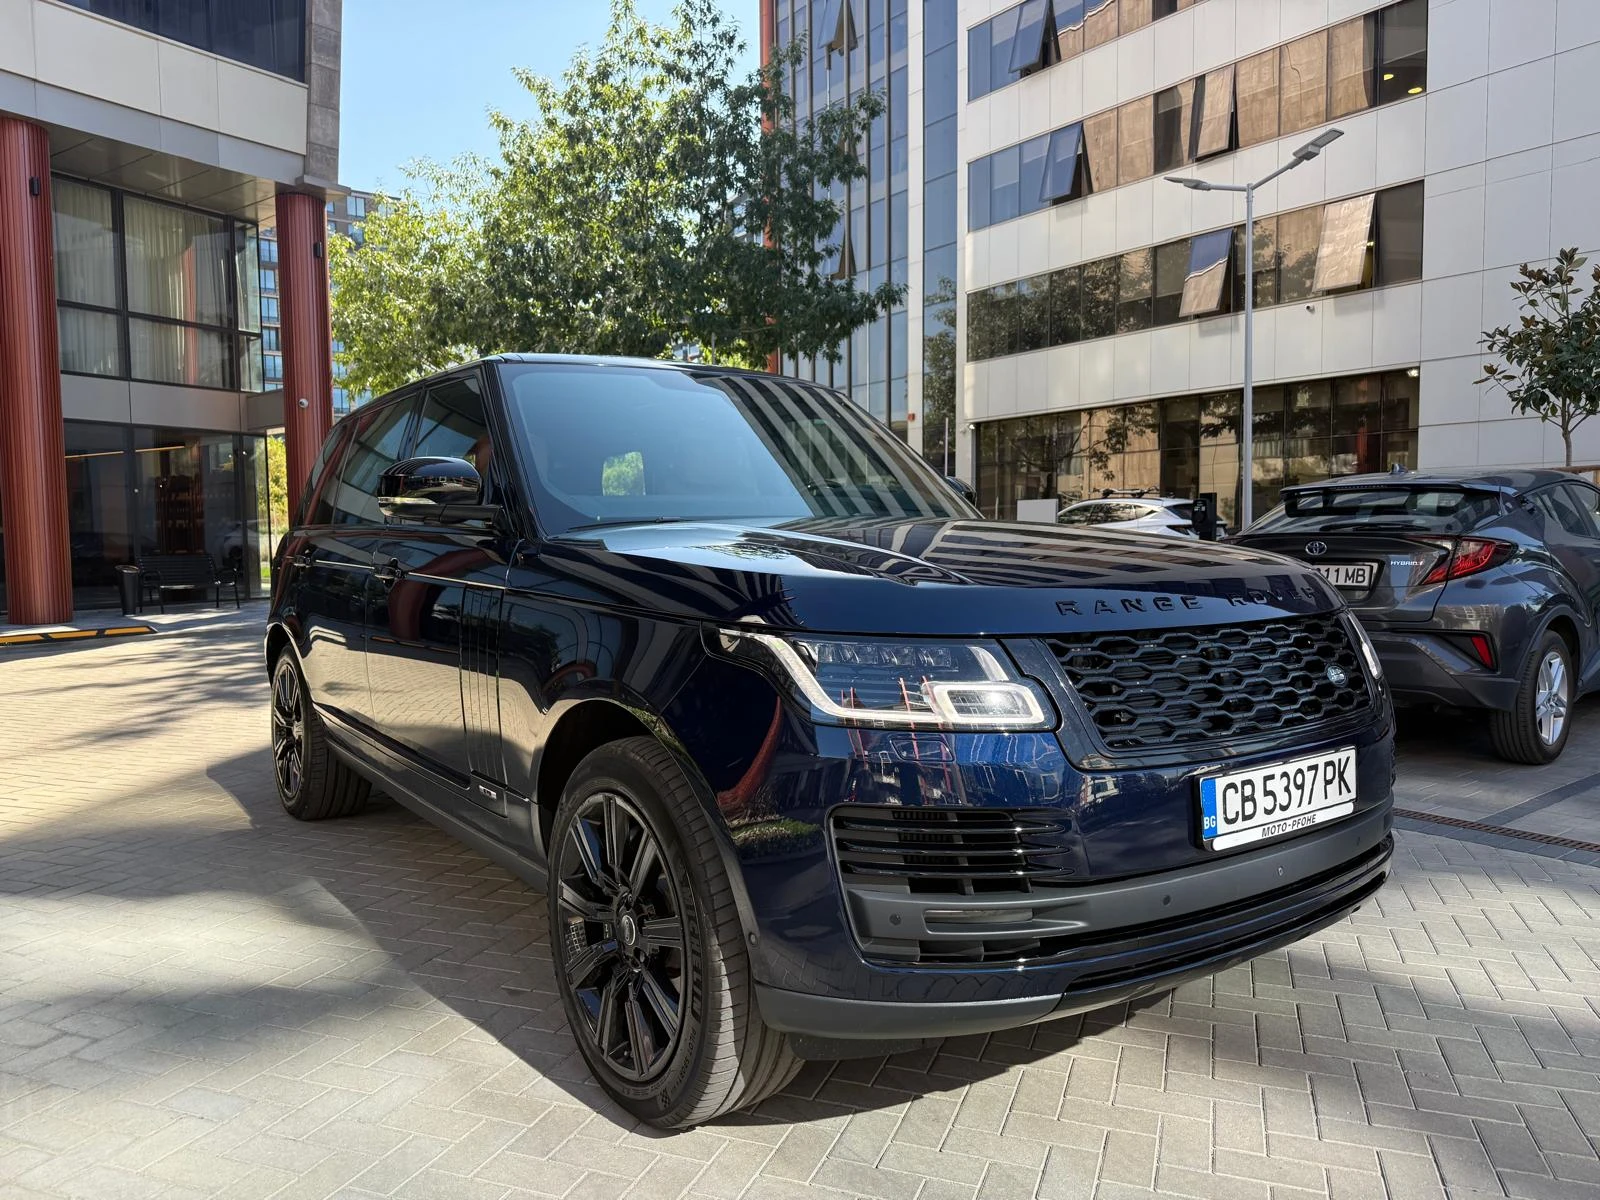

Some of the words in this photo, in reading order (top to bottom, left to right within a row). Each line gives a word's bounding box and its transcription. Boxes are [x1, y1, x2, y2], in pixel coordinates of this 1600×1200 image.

[1344, 567, 1366, 584] MB
[1055, 595, 1204, 616] RANGE
[1225, 587, 1315, 606] ROVER
[1222, 778, 1257, 825] CB
[1262, 763, 1319, 816] 5397
[1323, 756, 1352, 800] PK
[1203, 815, 1217, 830] BG
[1261, 813, 1317, 838] MOTO-PFOHE
[680, 884, 702, 1022] MICHELIN
[686, 1026, 697, 1056] PILOT
